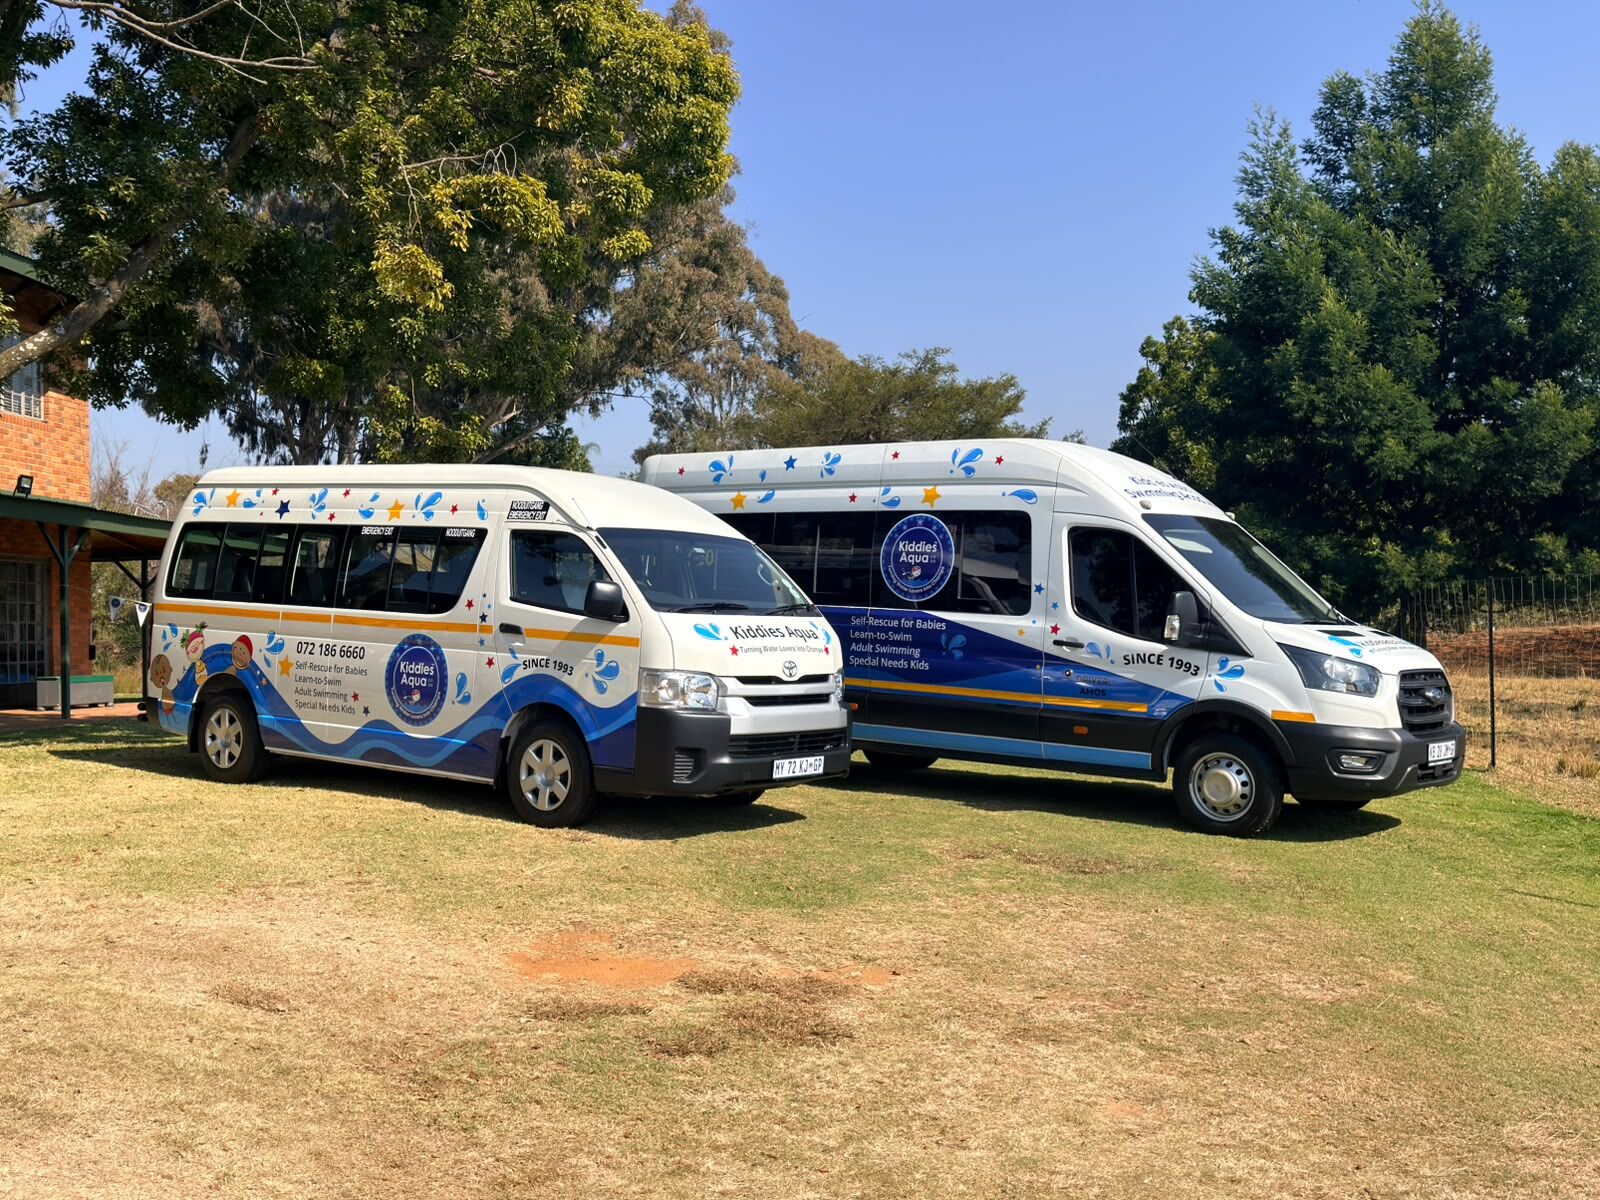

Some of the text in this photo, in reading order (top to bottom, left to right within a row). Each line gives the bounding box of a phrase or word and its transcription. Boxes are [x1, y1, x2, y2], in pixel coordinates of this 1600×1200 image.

[508, 510, 546, 519] EMERGENCY EXIT
[361, 526, 394, 535] EMERGENCY EXIT
[898, 541, 938, 552] Kiddies
[899, 552, 929, 565] Aqua
[851, 616, 946, 630] Self-Rescue for Babies
[729, 625, 818, 642] Kiddies Aqua
[850, 629, 912, 642] Learn-to-Swim
[297, 641, 365, 660] 072 186 6660
[850, 642, 920, 658] Adult Swimming
[295, 660, 368, 676] Self-Rescue for Babies
[400, 661, 434, 675] Kiddies
[522, 658, 574, 676] SINCE 1993
[849, 656, 929, 670] Special Needs Kids
[1123, 653, 1200, 676] SINCE 1993
[295, 674, 342, 686] Learn-to-Swim
[400, 674, 427, 688] Aqua
[295, 687, 348, 702] Adult Swimming
[1080, 688, 1106, 696] AMOS
[294, 699, 356, 714] Special Needs Kids
[788, 760, 796, 774] 72
[799, 759, 808, 773] KJ
[814, 758, 823, 771] GP
